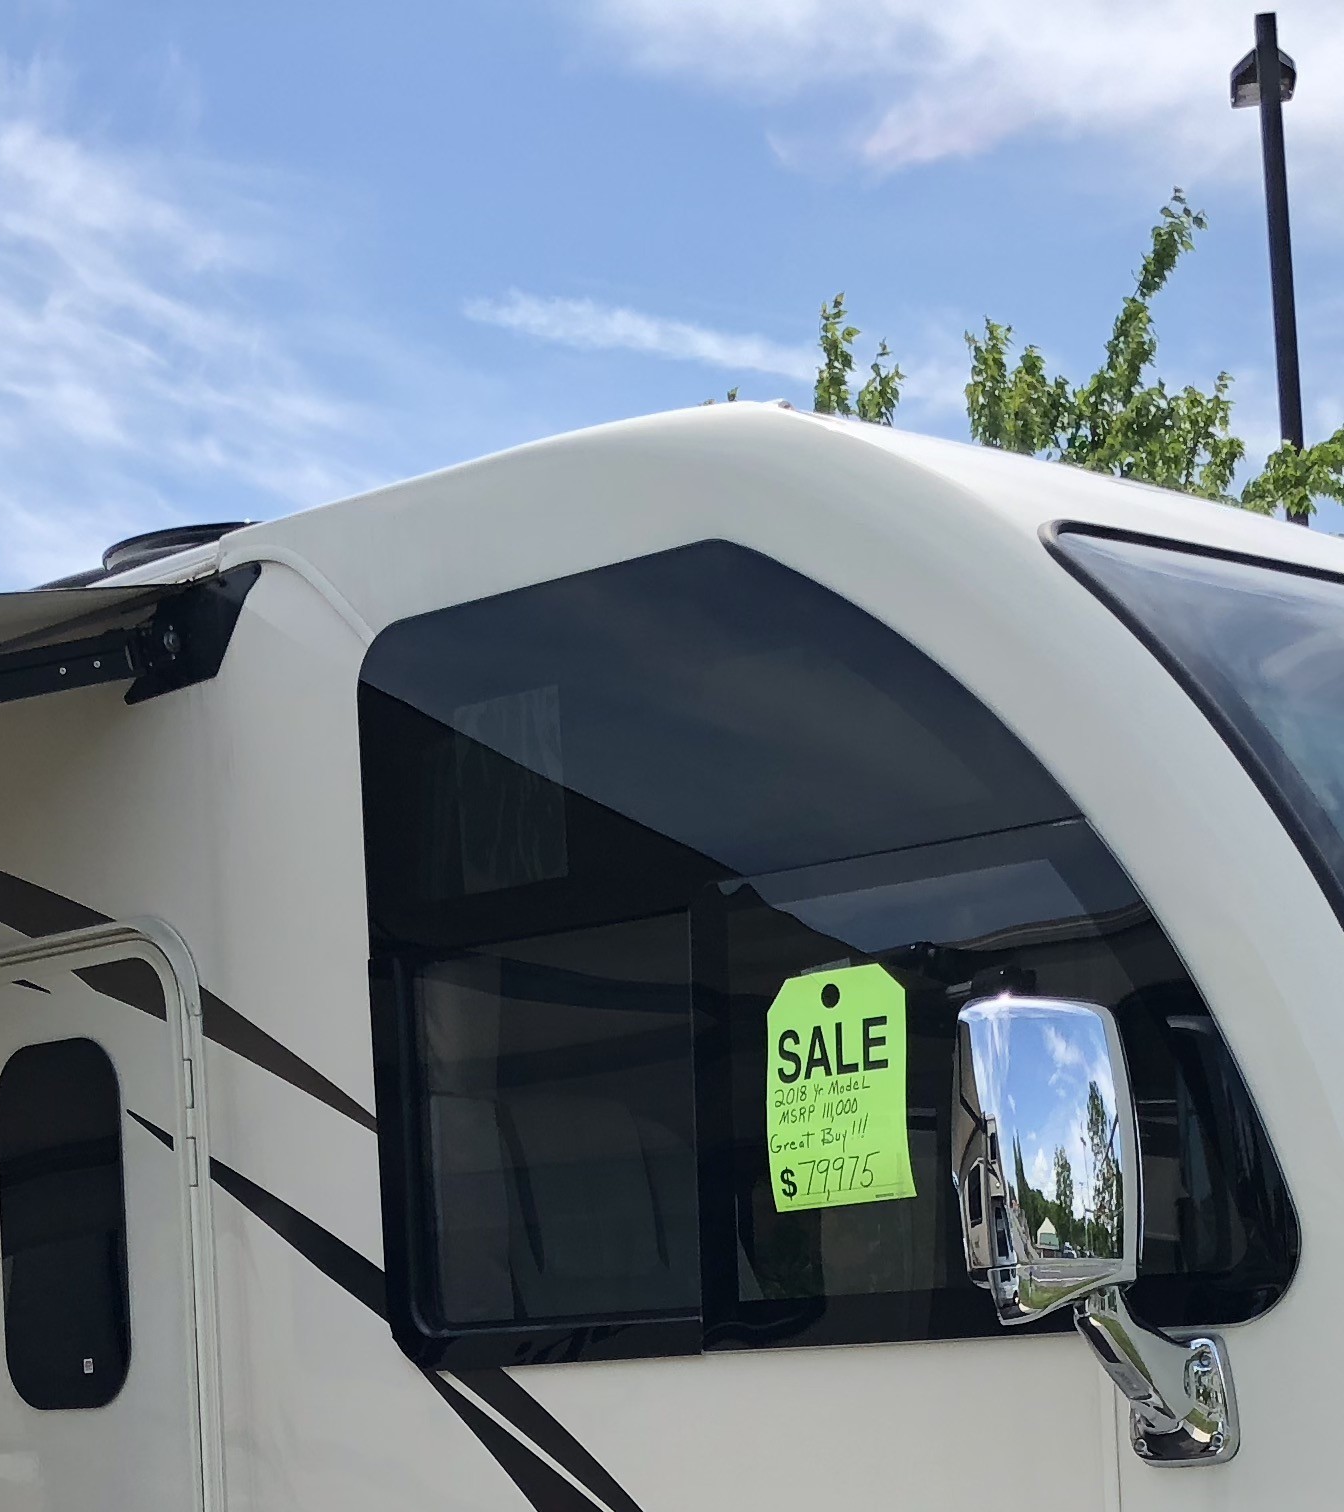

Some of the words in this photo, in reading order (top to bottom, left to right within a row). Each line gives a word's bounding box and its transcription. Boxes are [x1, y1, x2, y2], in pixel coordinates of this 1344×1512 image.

[778, 1016, 889, 1084] SALE
[774, 1085, 807, 1108] 2018
[778, 1104, 815, 1126] MSRP
[770, 1131, 815, 1154] Great
